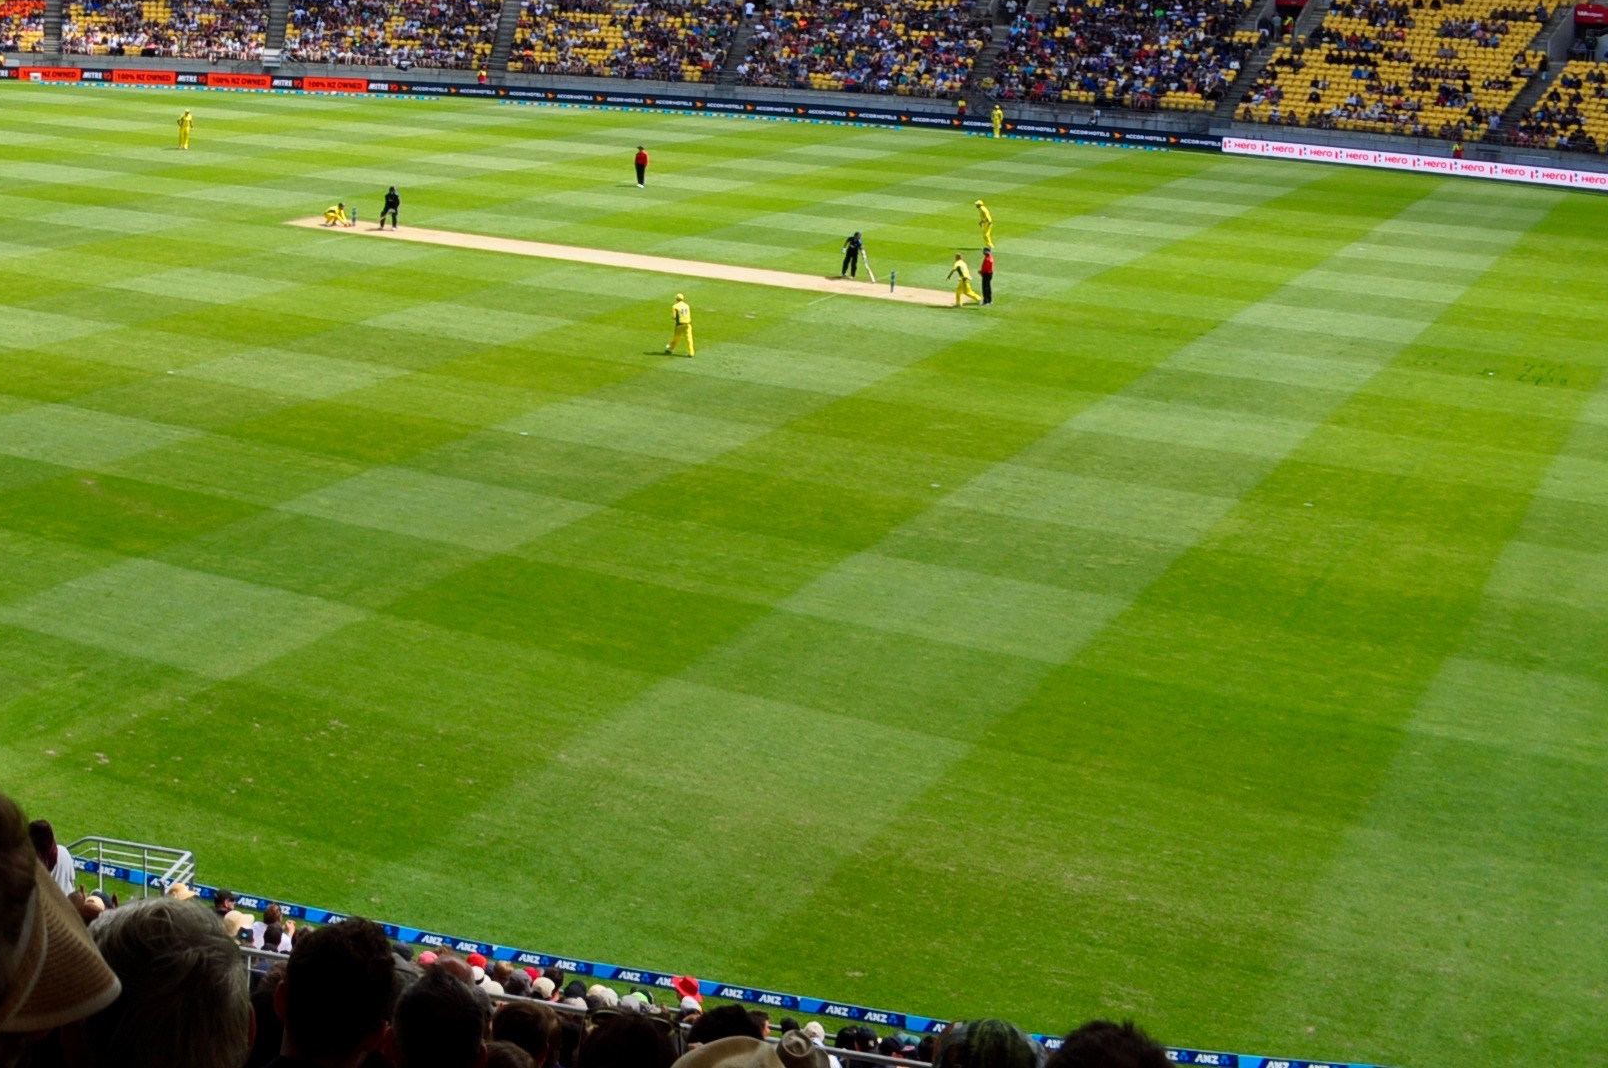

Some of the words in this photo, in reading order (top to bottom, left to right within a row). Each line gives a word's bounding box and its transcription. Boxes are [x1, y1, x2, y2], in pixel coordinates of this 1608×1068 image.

[618, 970, 641, 982] ANZ
[720, 987, 743, 999] ANZ
[758, 994, 781, 1006] ANZ
[826, 1005, 849, 1017] ANZ
[864, 1011, 887, 1023] ANZ
[1194, 1053, 1219, 1064] ANZ
